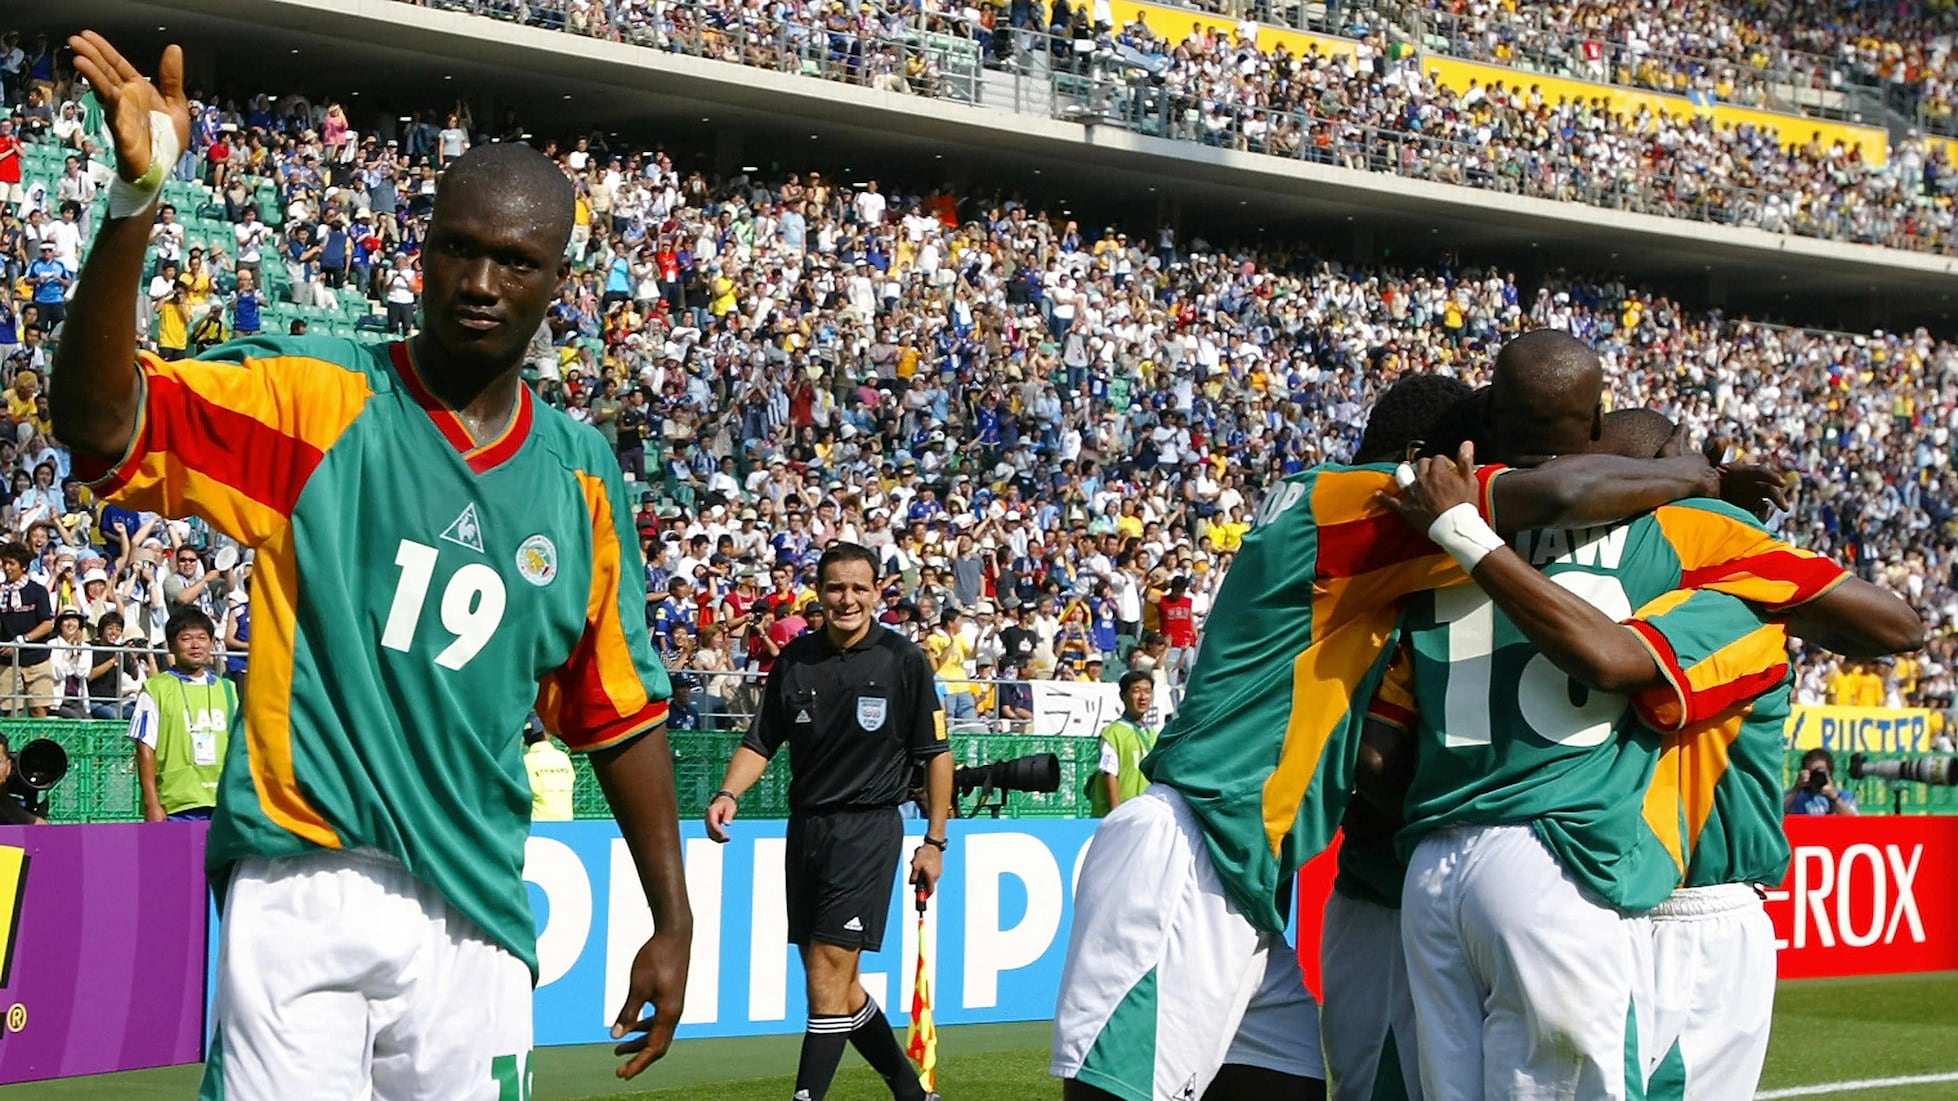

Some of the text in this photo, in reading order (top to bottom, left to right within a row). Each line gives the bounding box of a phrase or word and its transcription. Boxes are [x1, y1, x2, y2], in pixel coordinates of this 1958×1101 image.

[381, 538, 507, 671] 19
[1434, 571, 1632, 748] 18
[183, 708, 227, 732] LAB
